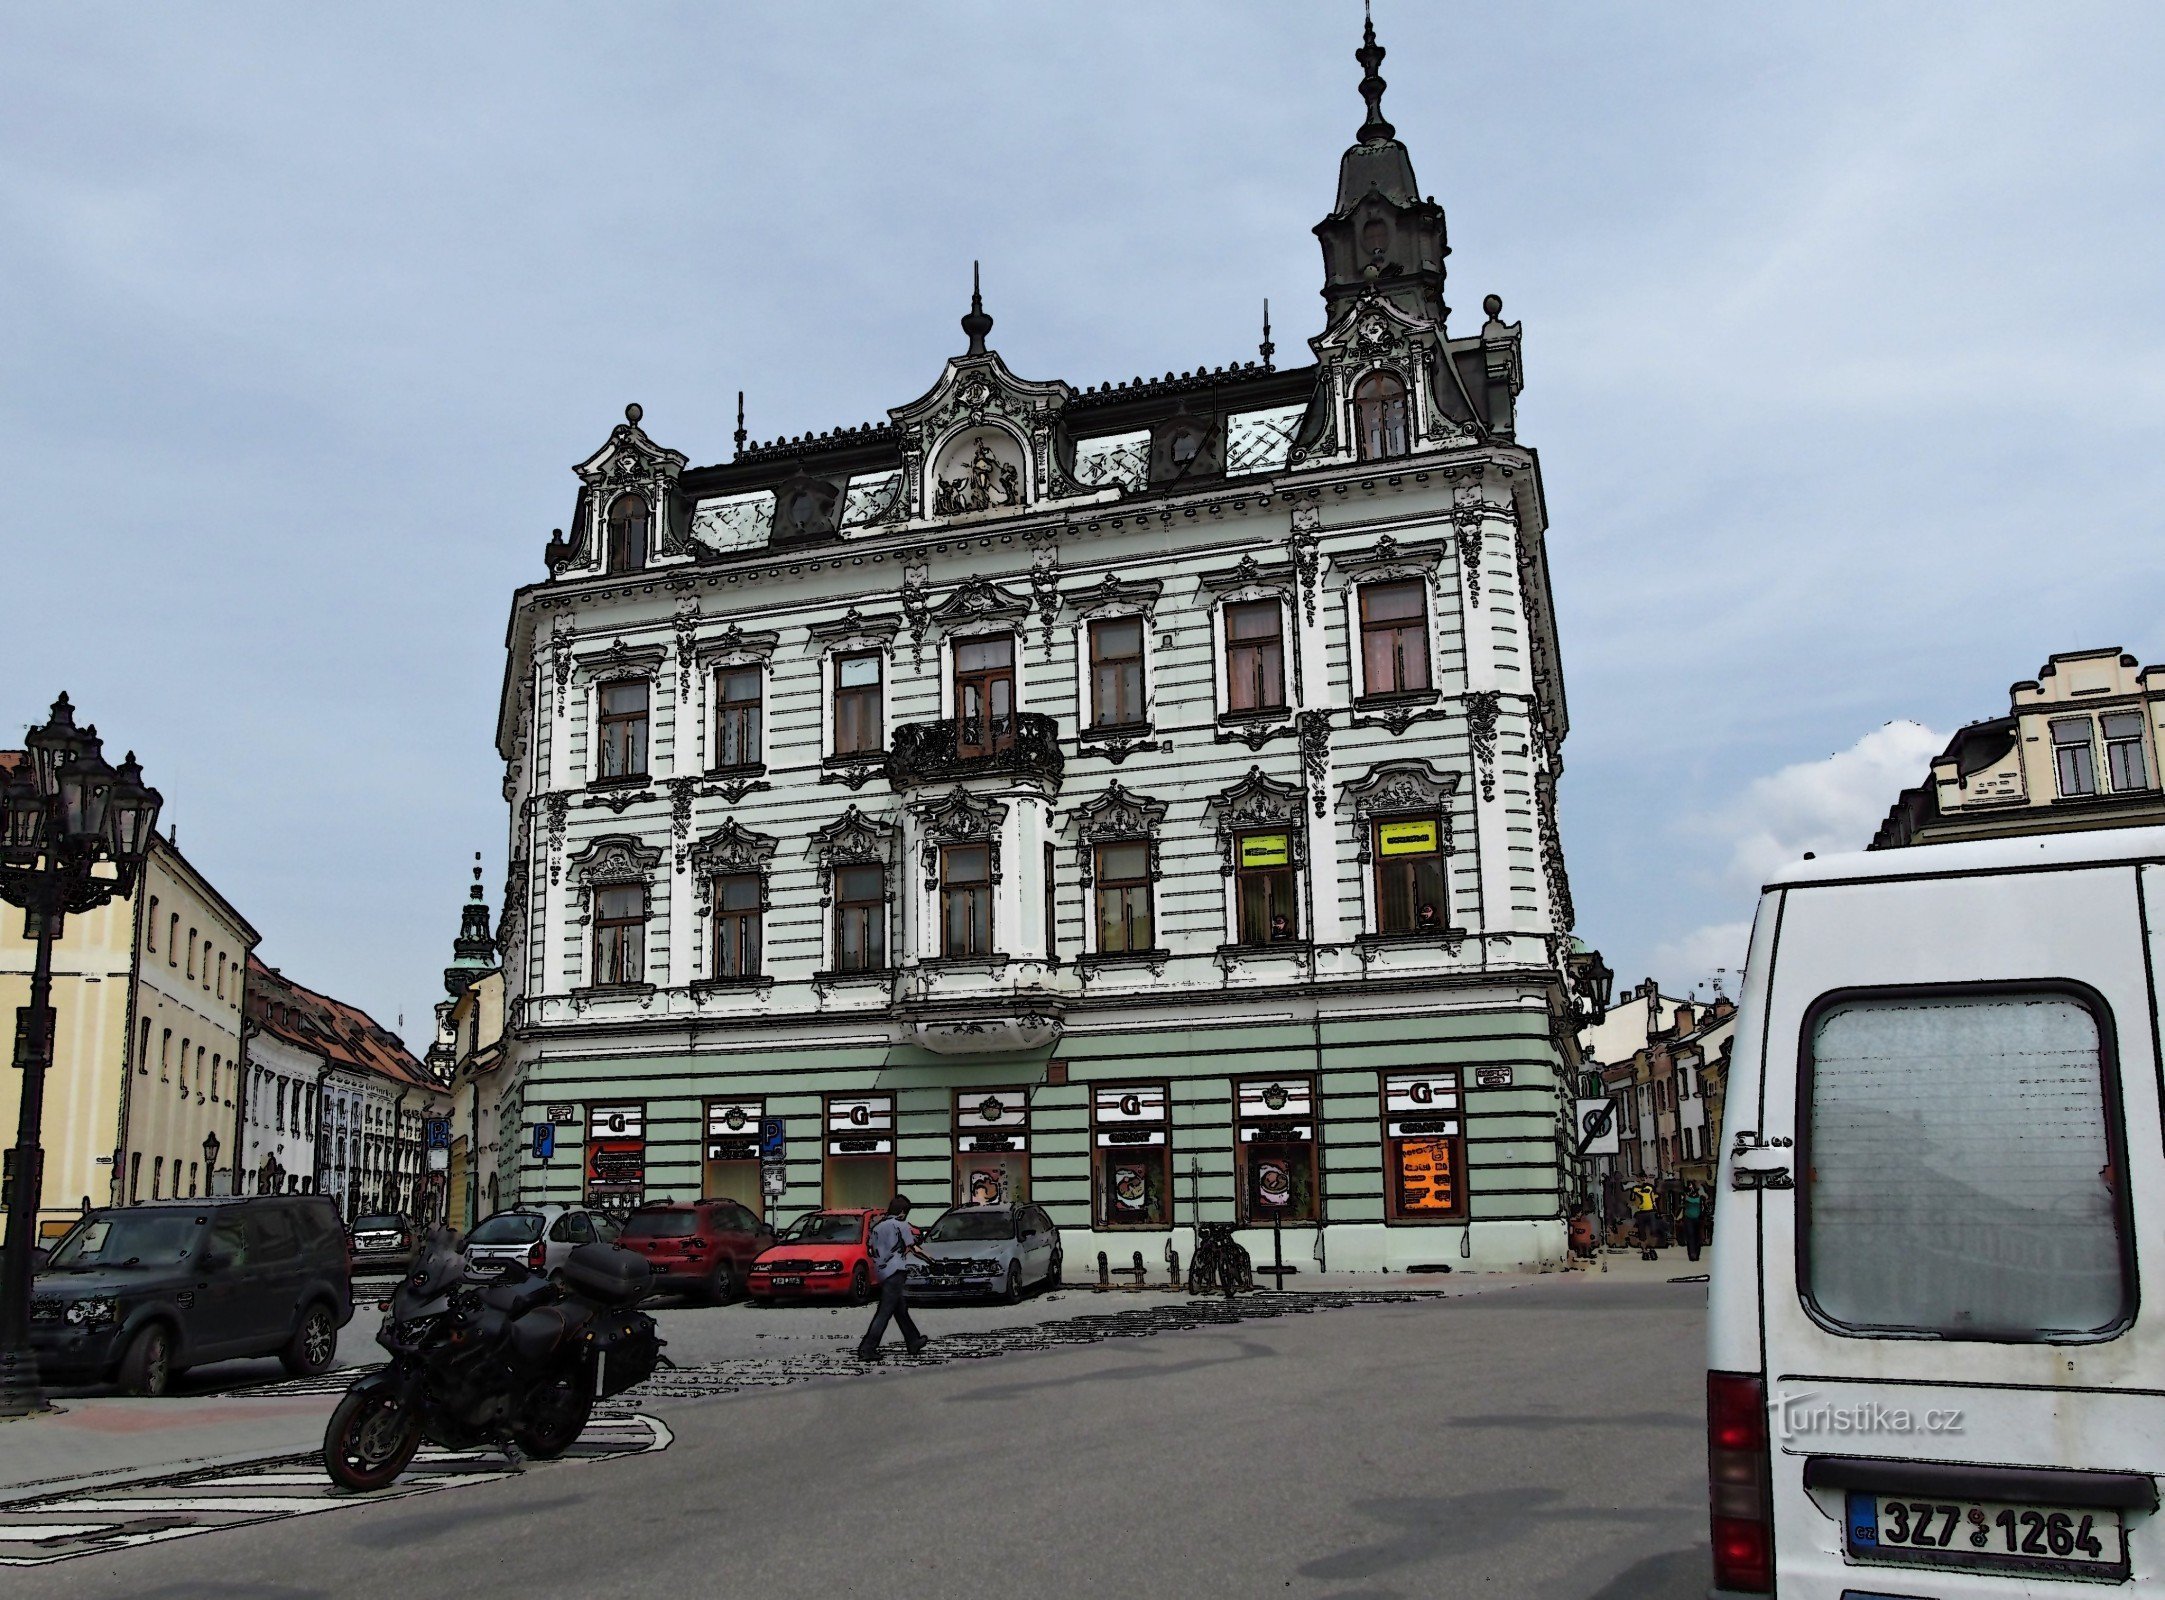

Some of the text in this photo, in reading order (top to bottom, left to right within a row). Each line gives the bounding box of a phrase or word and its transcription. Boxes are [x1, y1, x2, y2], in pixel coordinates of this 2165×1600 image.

[1410, 1082, 1432, 1104] G
[1120, 1095, 1141, 1115] G
[608, 1113, 626, 1132] G
[851, 1106, 869, 1125] G
[433, 1122, 444, 1138] P
[538, 1126, 548, 1145] P
[766, 1124, 778, 1142] P
[1854, 1525, 1875, 1540] CZ
[1885, 1502, 2102, 1557] 3Z7 1264
